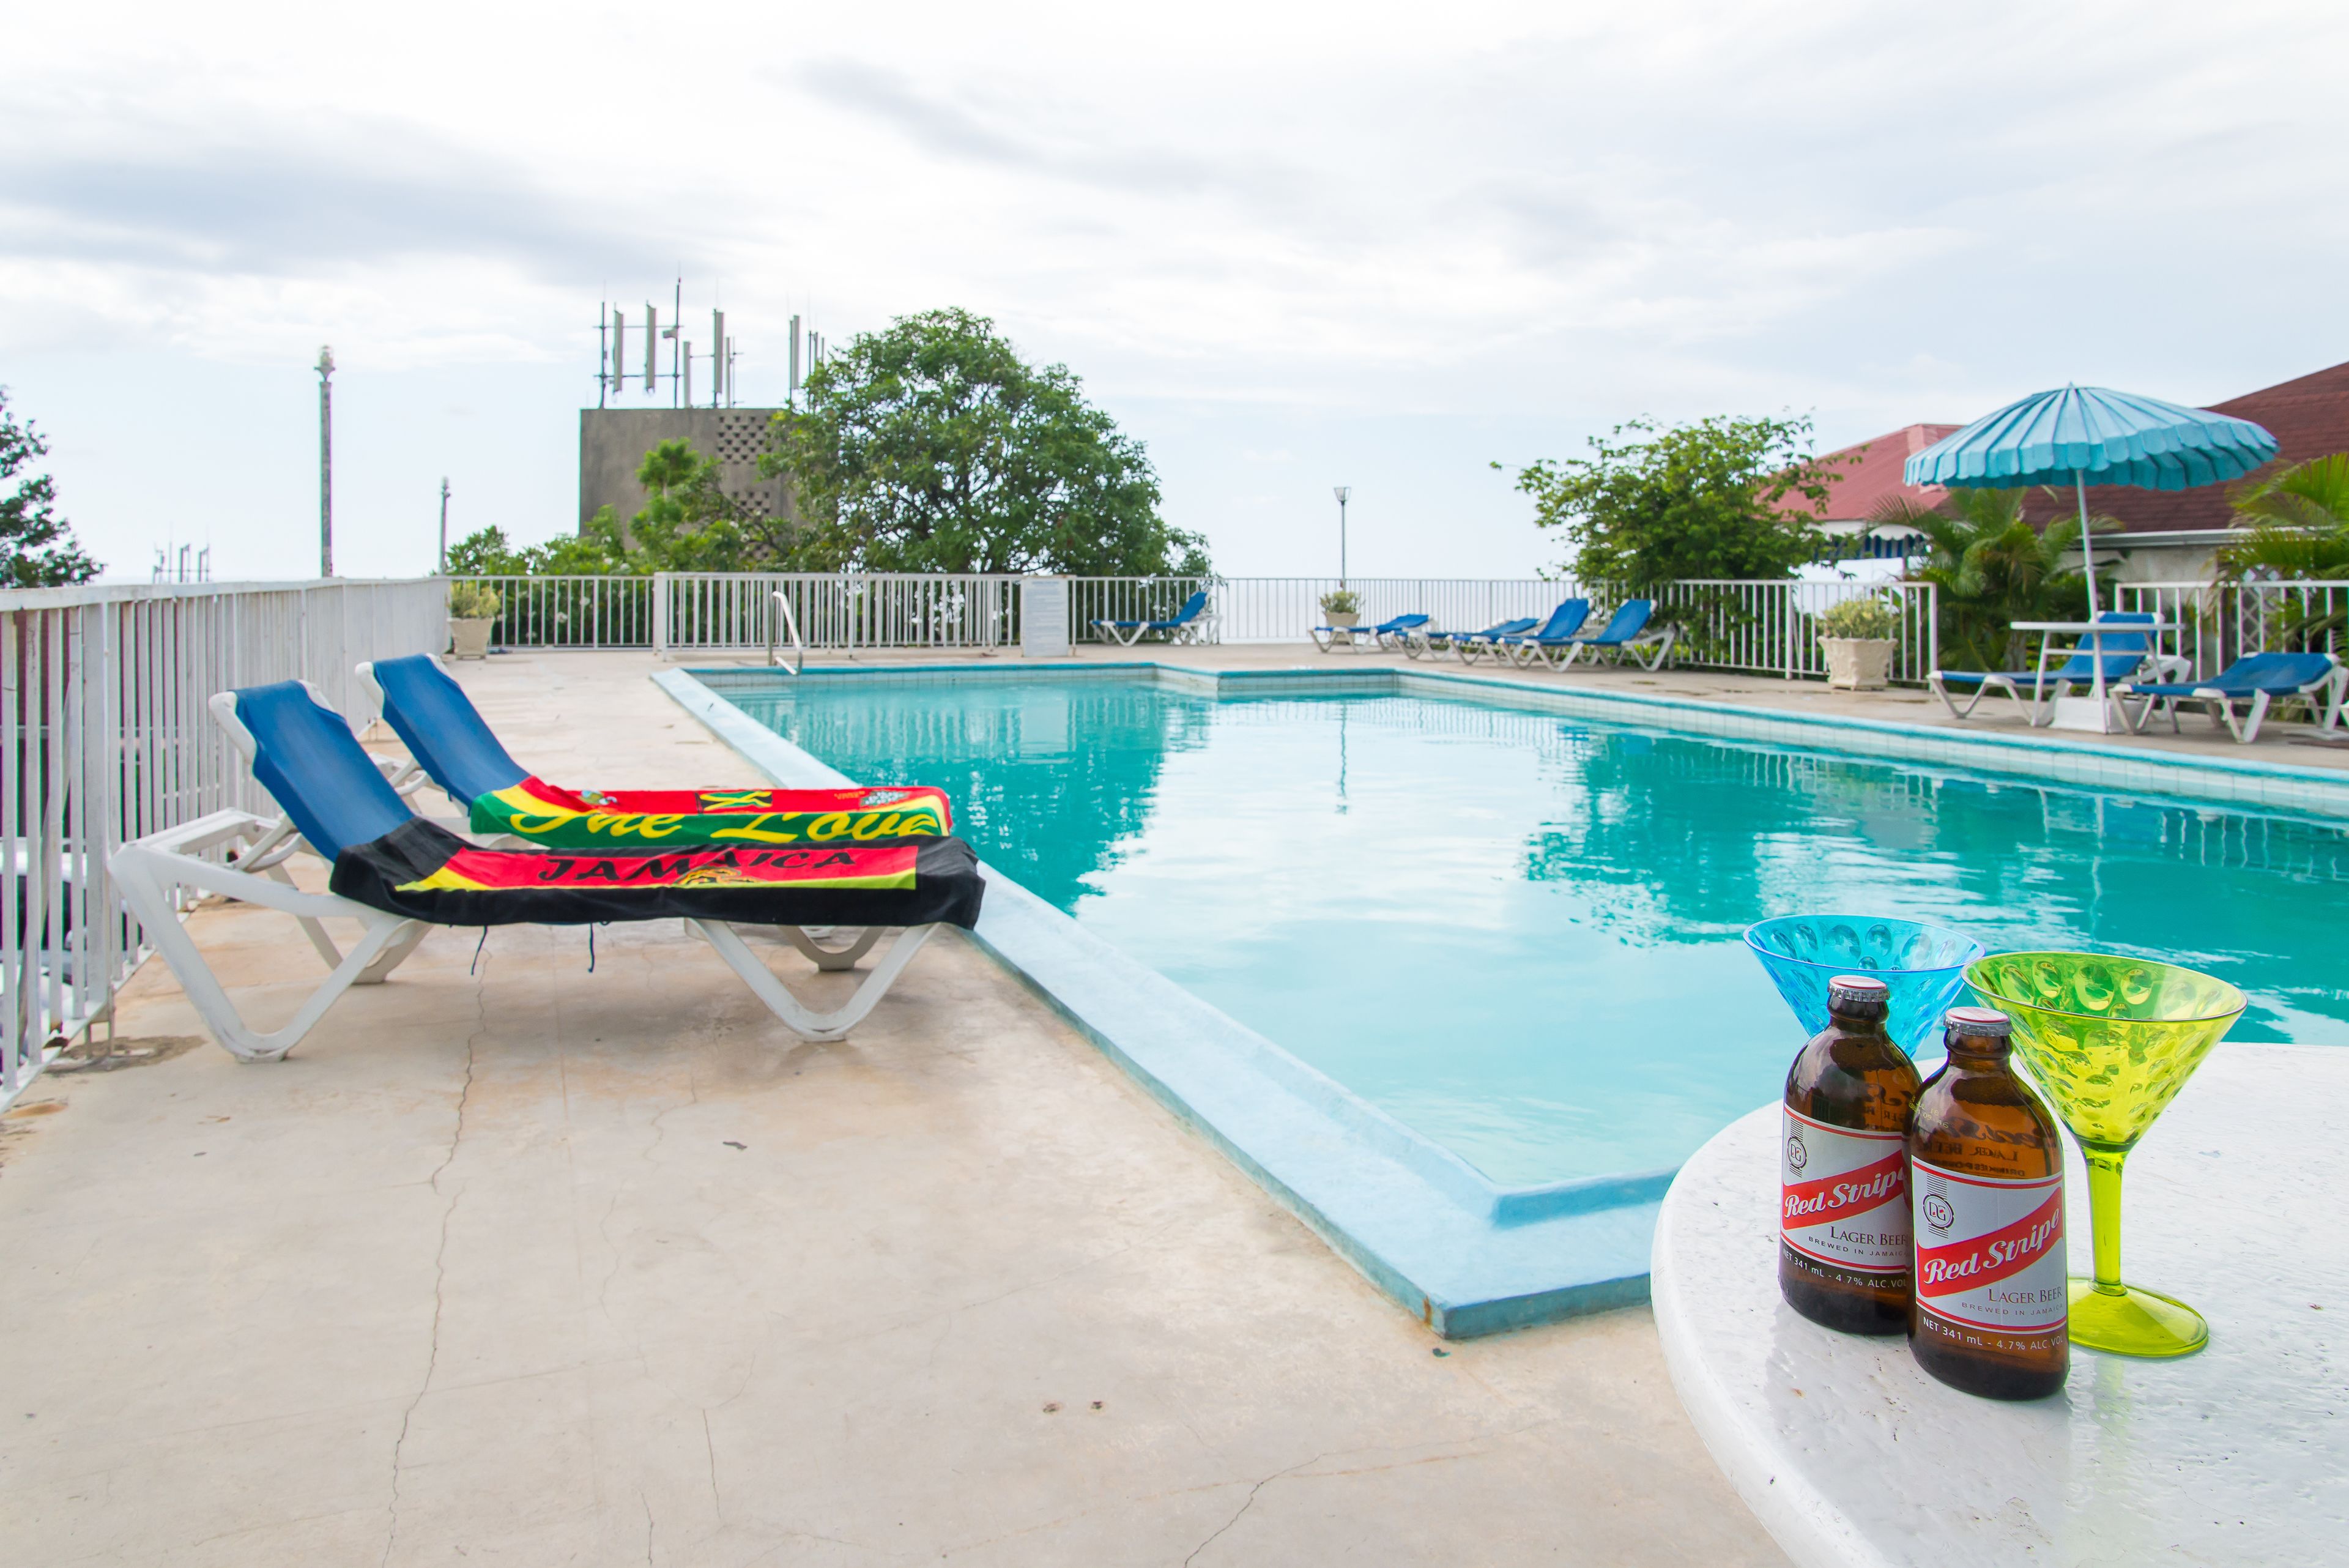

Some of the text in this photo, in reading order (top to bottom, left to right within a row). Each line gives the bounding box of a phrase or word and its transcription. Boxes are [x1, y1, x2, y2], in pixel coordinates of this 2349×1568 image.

[538, 850, 856, 881] JAMAICA
[1784, 1192, 1827, 1219] Red
[1808, 1236, 1849, 1252] BREWED
[1830, 1225, 1876, 1246] LAGER
[1923, 1208, 2060, 1285] Red Stripe
[1794, 1257, 1808, 1270] 341
[1811, 1267, 1824, 1277] mL
[1835, 1274, 1863, 1287] 4.7%
[1962, 1302, 2009, 1315] BREWED
[2030, 1303, 2063, 1315] JAMAICA
[1987, 1286, 2062, 1304] LAGER BEER
[1923, 1317, 1939, 1332] NET
[1942, 1326, 1961, 1340] 341
[1967, 1336, 1983, 1346] mL
[1997, 1340, 2025, 1350] 4.7%
